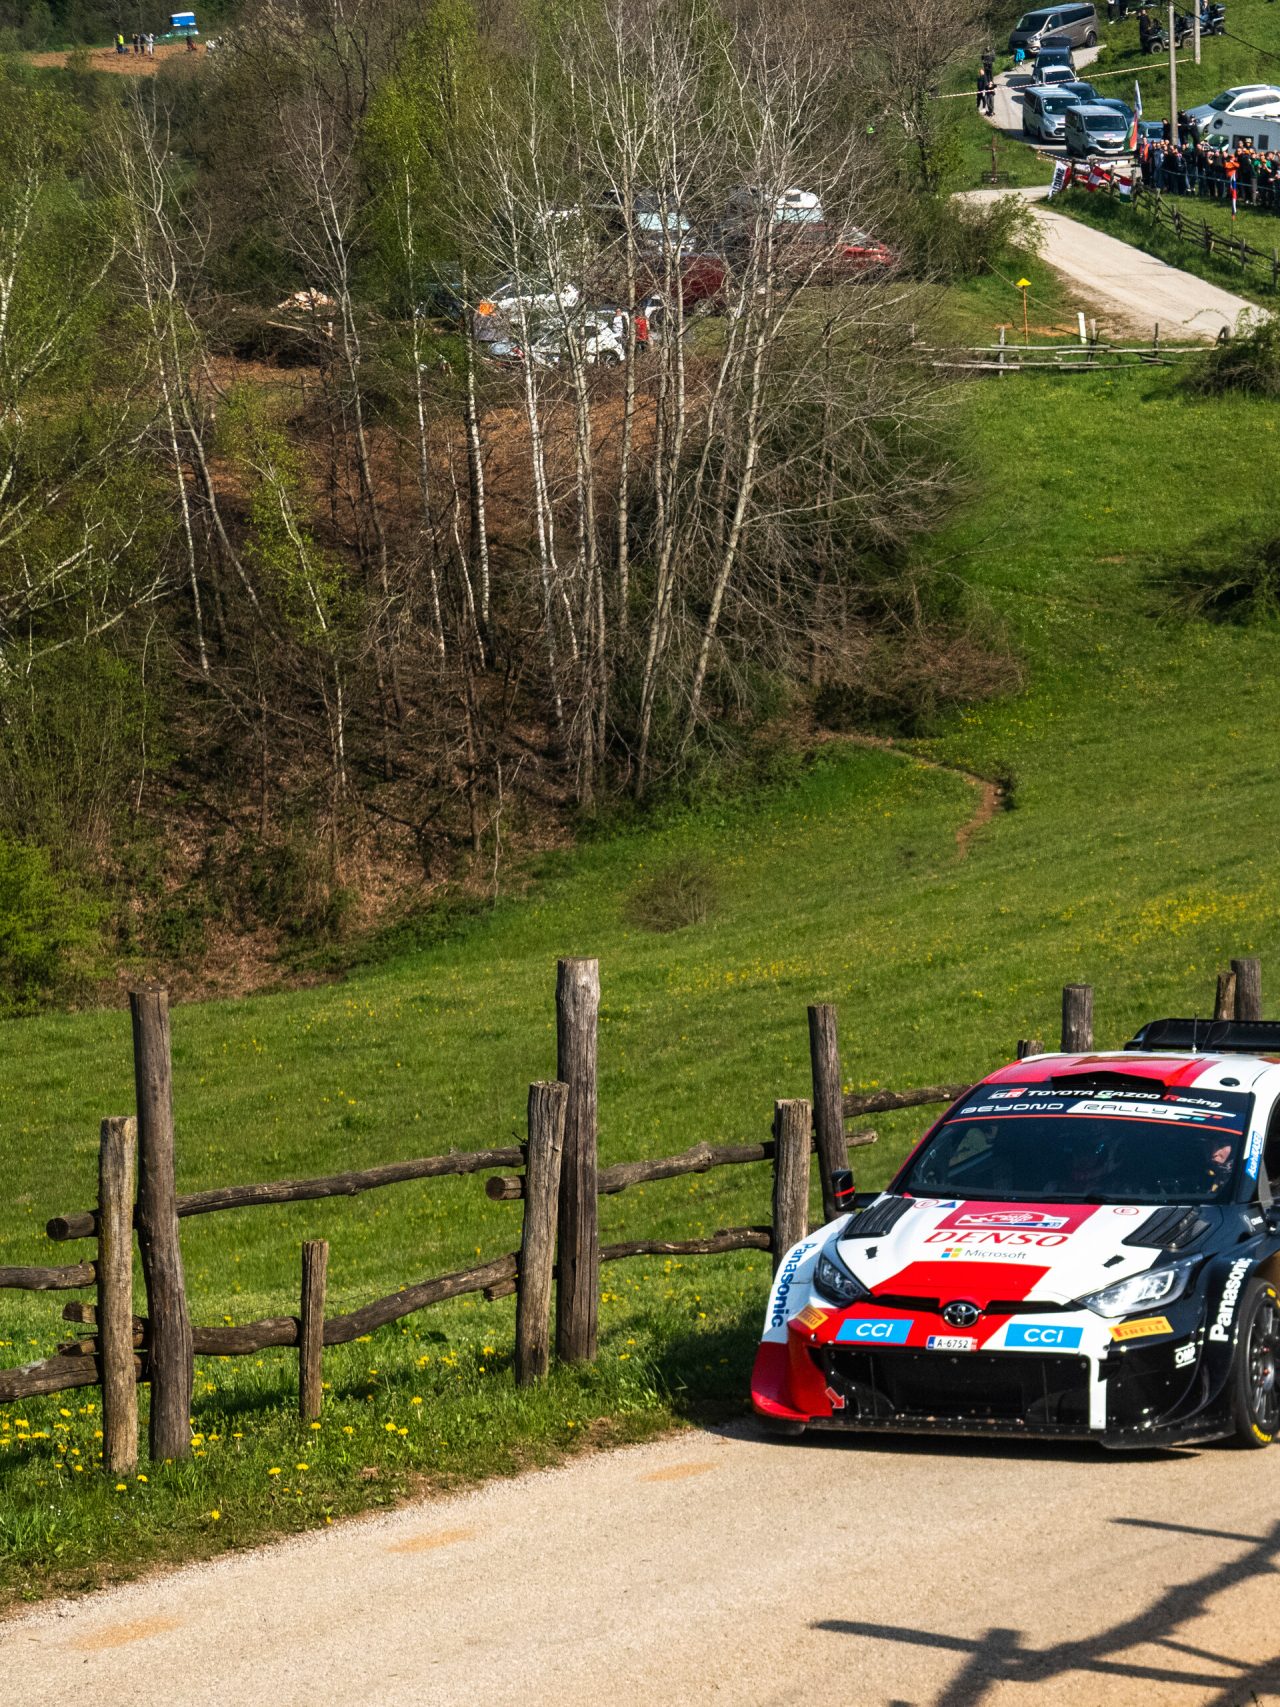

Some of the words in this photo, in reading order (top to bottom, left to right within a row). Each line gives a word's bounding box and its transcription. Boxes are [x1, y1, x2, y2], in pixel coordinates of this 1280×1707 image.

[1028, 1089, 1095, 1097] TOYOTA
[1094, 1090, 1161, 1100] GAZOO
[1163, 1094, 1223, 1108] Racing
[960, 1102, 1065, 1115] BEYOND
[1083, 1103, 1169, 1115] RALLY
[923, 1231, 1070, 1248] DENSO
[963, 1249, 1028, 1260] Microsoft
[771, 1243, 818, 1329] Panasonic
[1208, 1257, 1254, 1342] Panasonic
[856, 1323, 895, 1338] CCI
[1023, 1328, 1064, 1343] CCI
[1114, 1320, 1168, 1337] PIRELLI
[936, 1339, 969, 1349] A-6752
